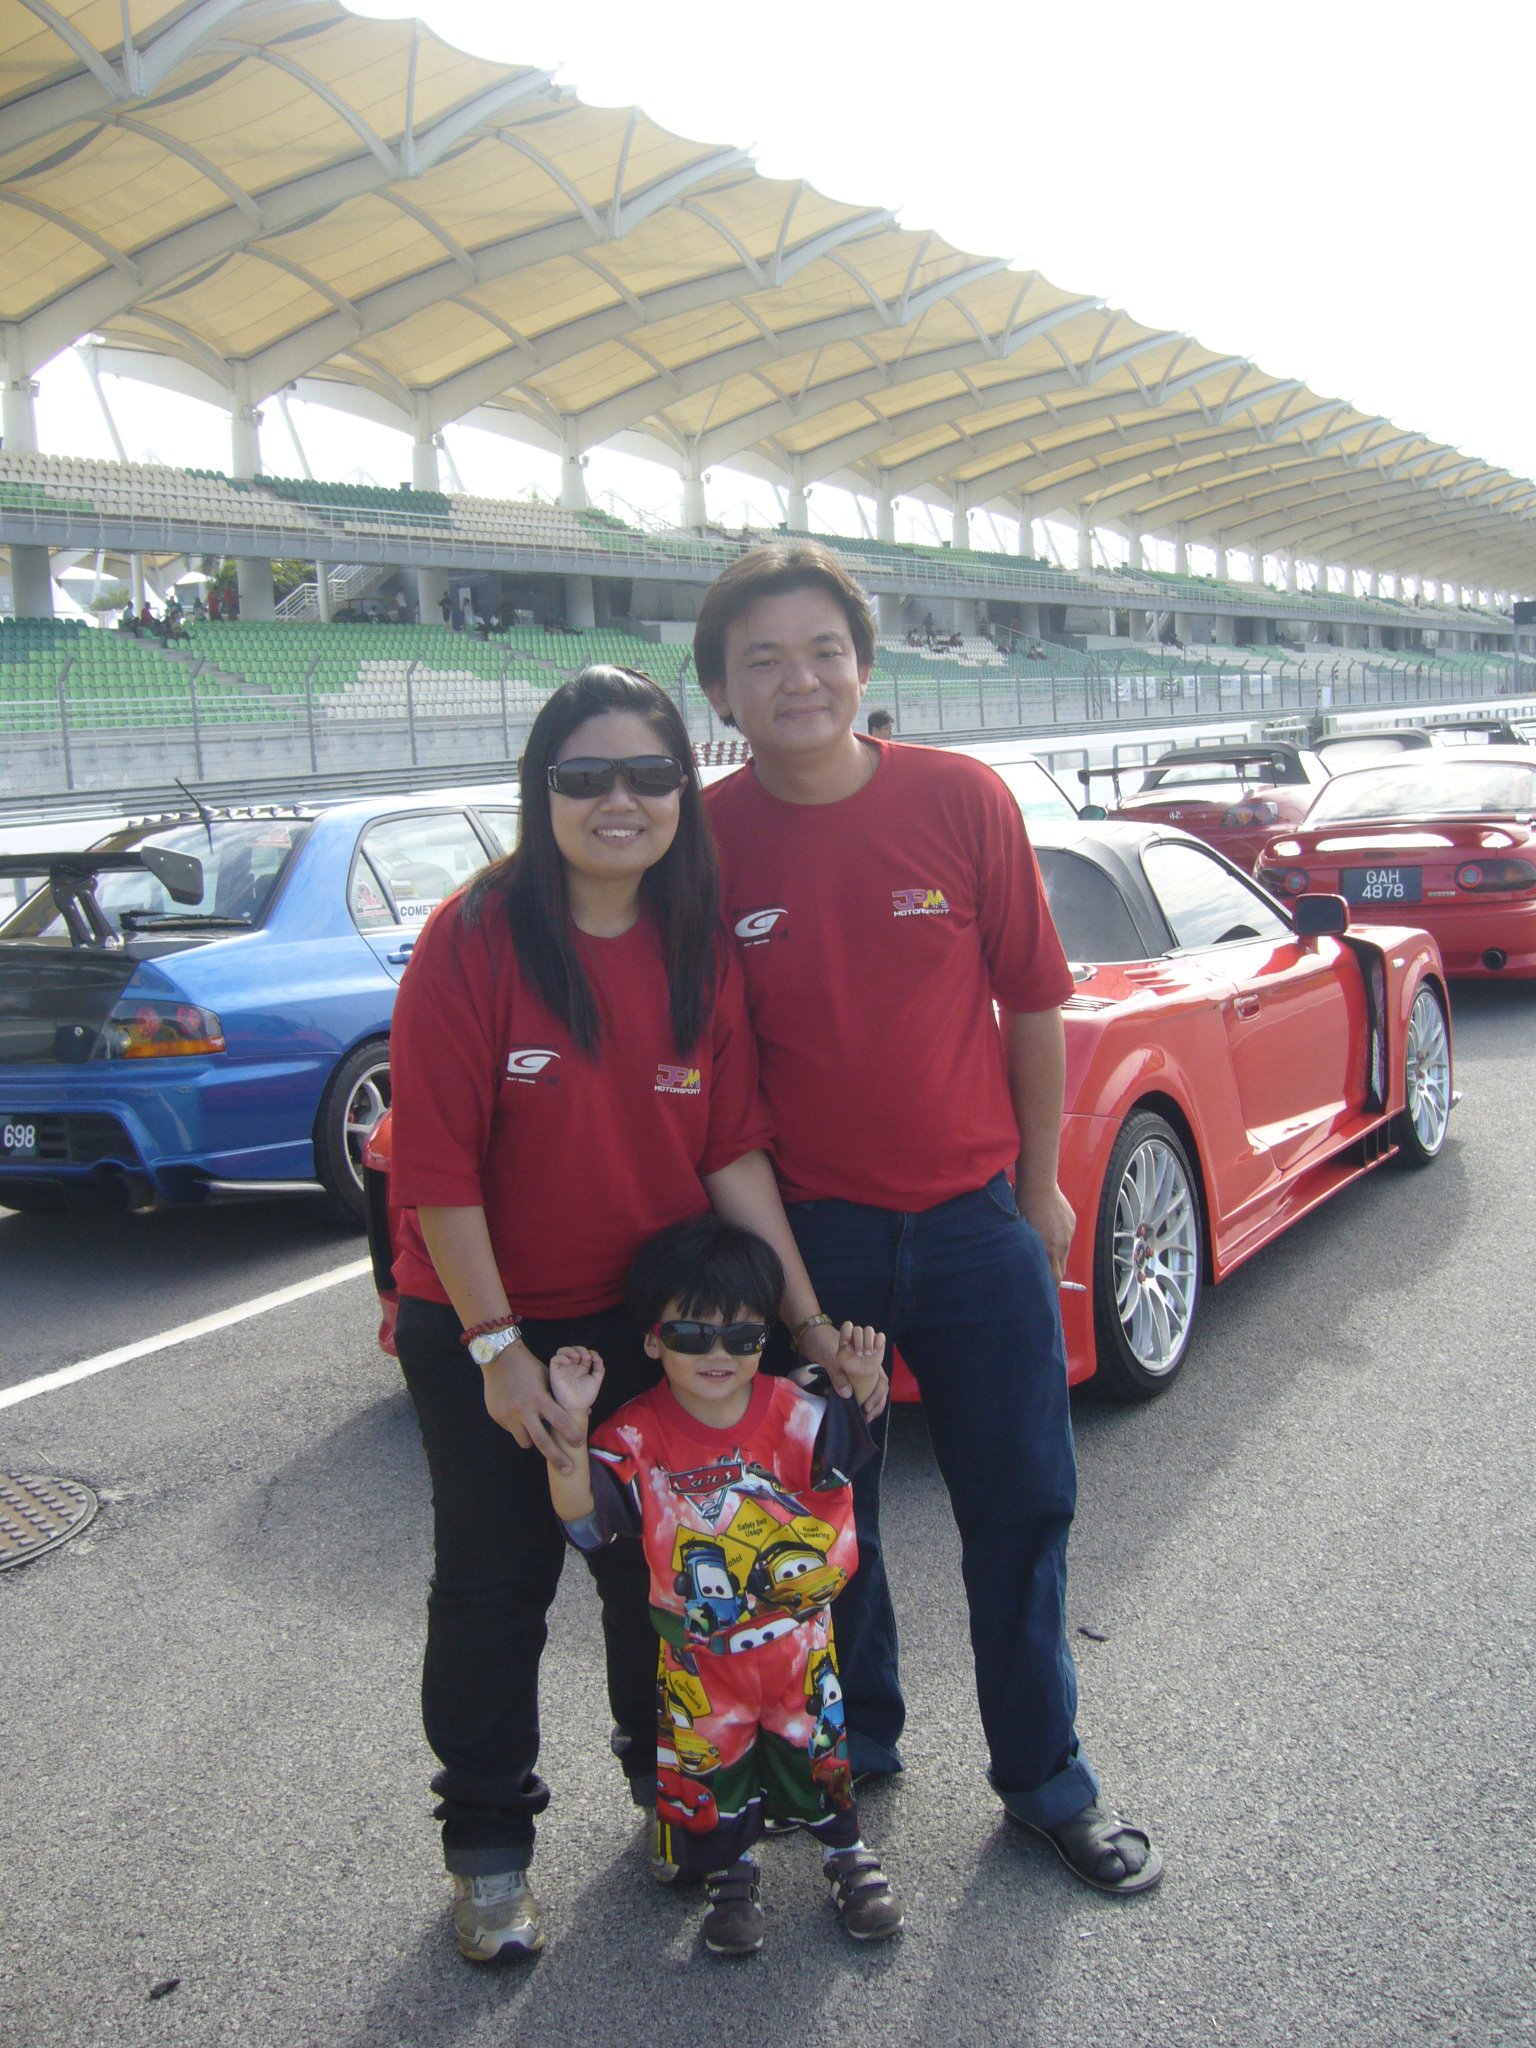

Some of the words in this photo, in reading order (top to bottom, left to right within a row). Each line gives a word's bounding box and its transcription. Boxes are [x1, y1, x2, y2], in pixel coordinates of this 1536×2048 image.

[1361, 883, 1404, 899] 4878
[400, 904, 437, 917] COMET
[4, 1124, 36, 1148] 698
[736, 1522, 756, 1533] Safety
[744, 1528, 763, 1538] Usage
